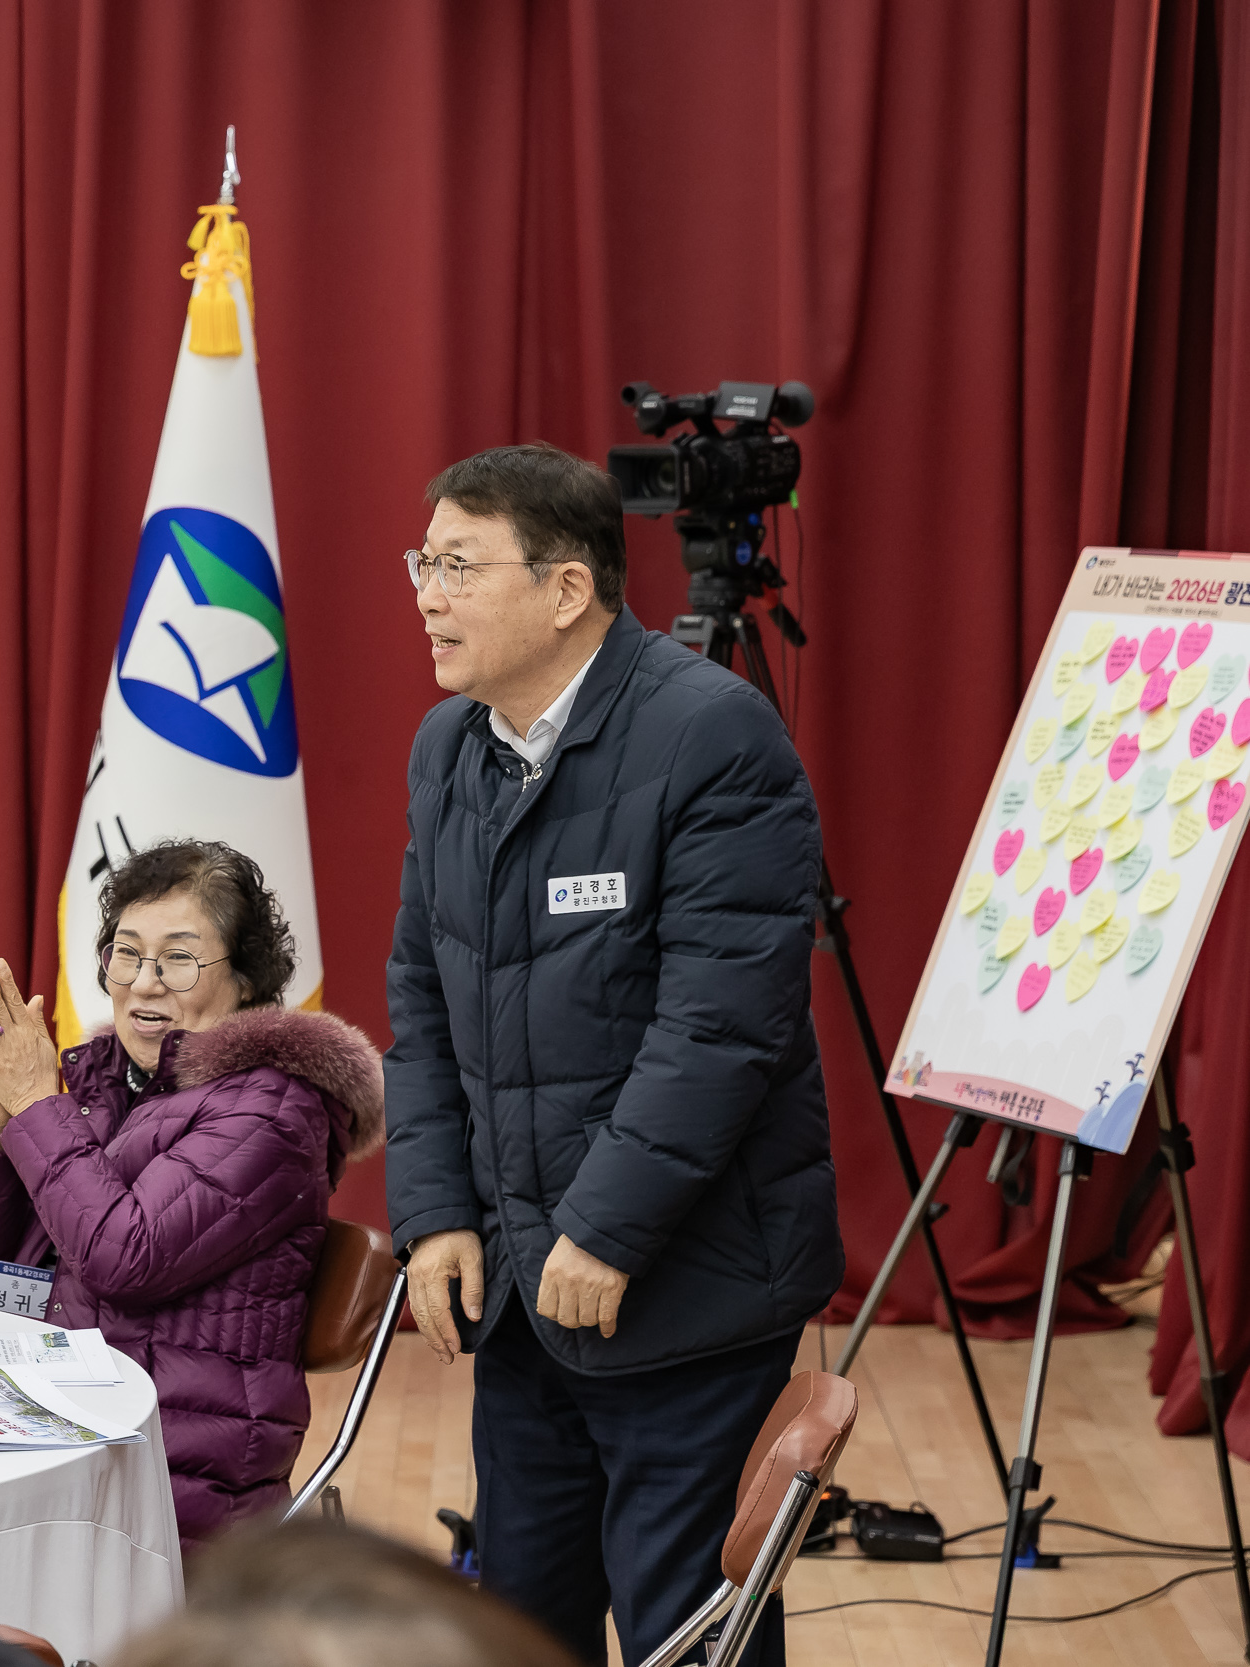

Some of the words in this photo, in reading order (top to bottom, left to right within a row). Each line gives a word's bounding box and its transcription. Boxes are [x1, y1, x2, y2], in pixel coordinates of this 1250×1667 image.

[1166, 579, 1225, 603] 2026년
[572, 878, 617, 894] 김경호
[574, 895, 617, 906] 광진구청장
[11, 1280, 38, 1292] 총무
